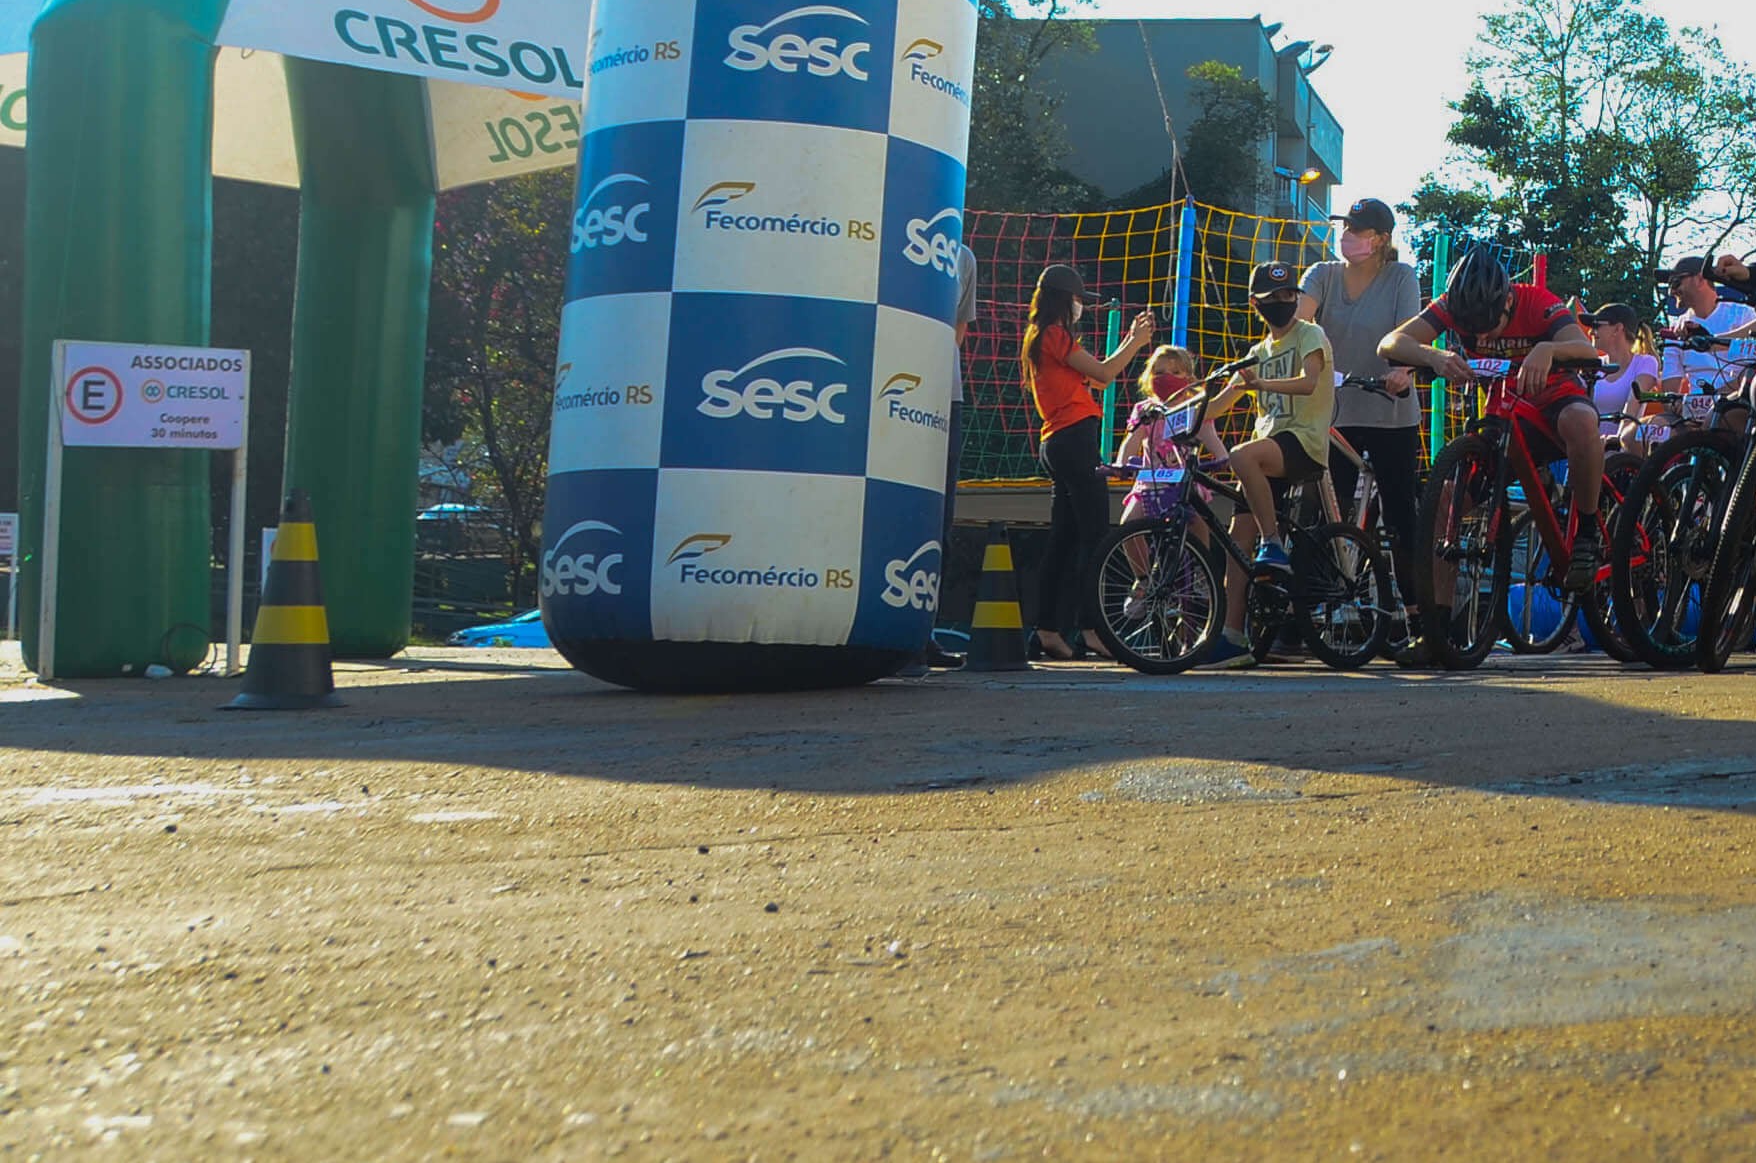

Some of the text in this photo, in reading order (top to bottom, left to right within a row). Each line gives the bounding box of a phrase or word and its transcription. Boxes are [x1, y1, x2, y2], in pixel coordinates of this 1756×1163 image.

[333, 9, 584, 90] CRESOL
[655, 41, 681, 60] RS
[704, 210, 876, 241] Fecomércio RS
[131, 355, 243, 373] ASSOCIADOS
[82, 380, 106, 411] E
[166, 385, 230, 401] CRESOL
[625, 385, 654, 405] RS
[159, 413, 211, 426] Coopere
[169, 427, 218, 440] minutos
[680, 564, 854, 589] Fecomércio RS
